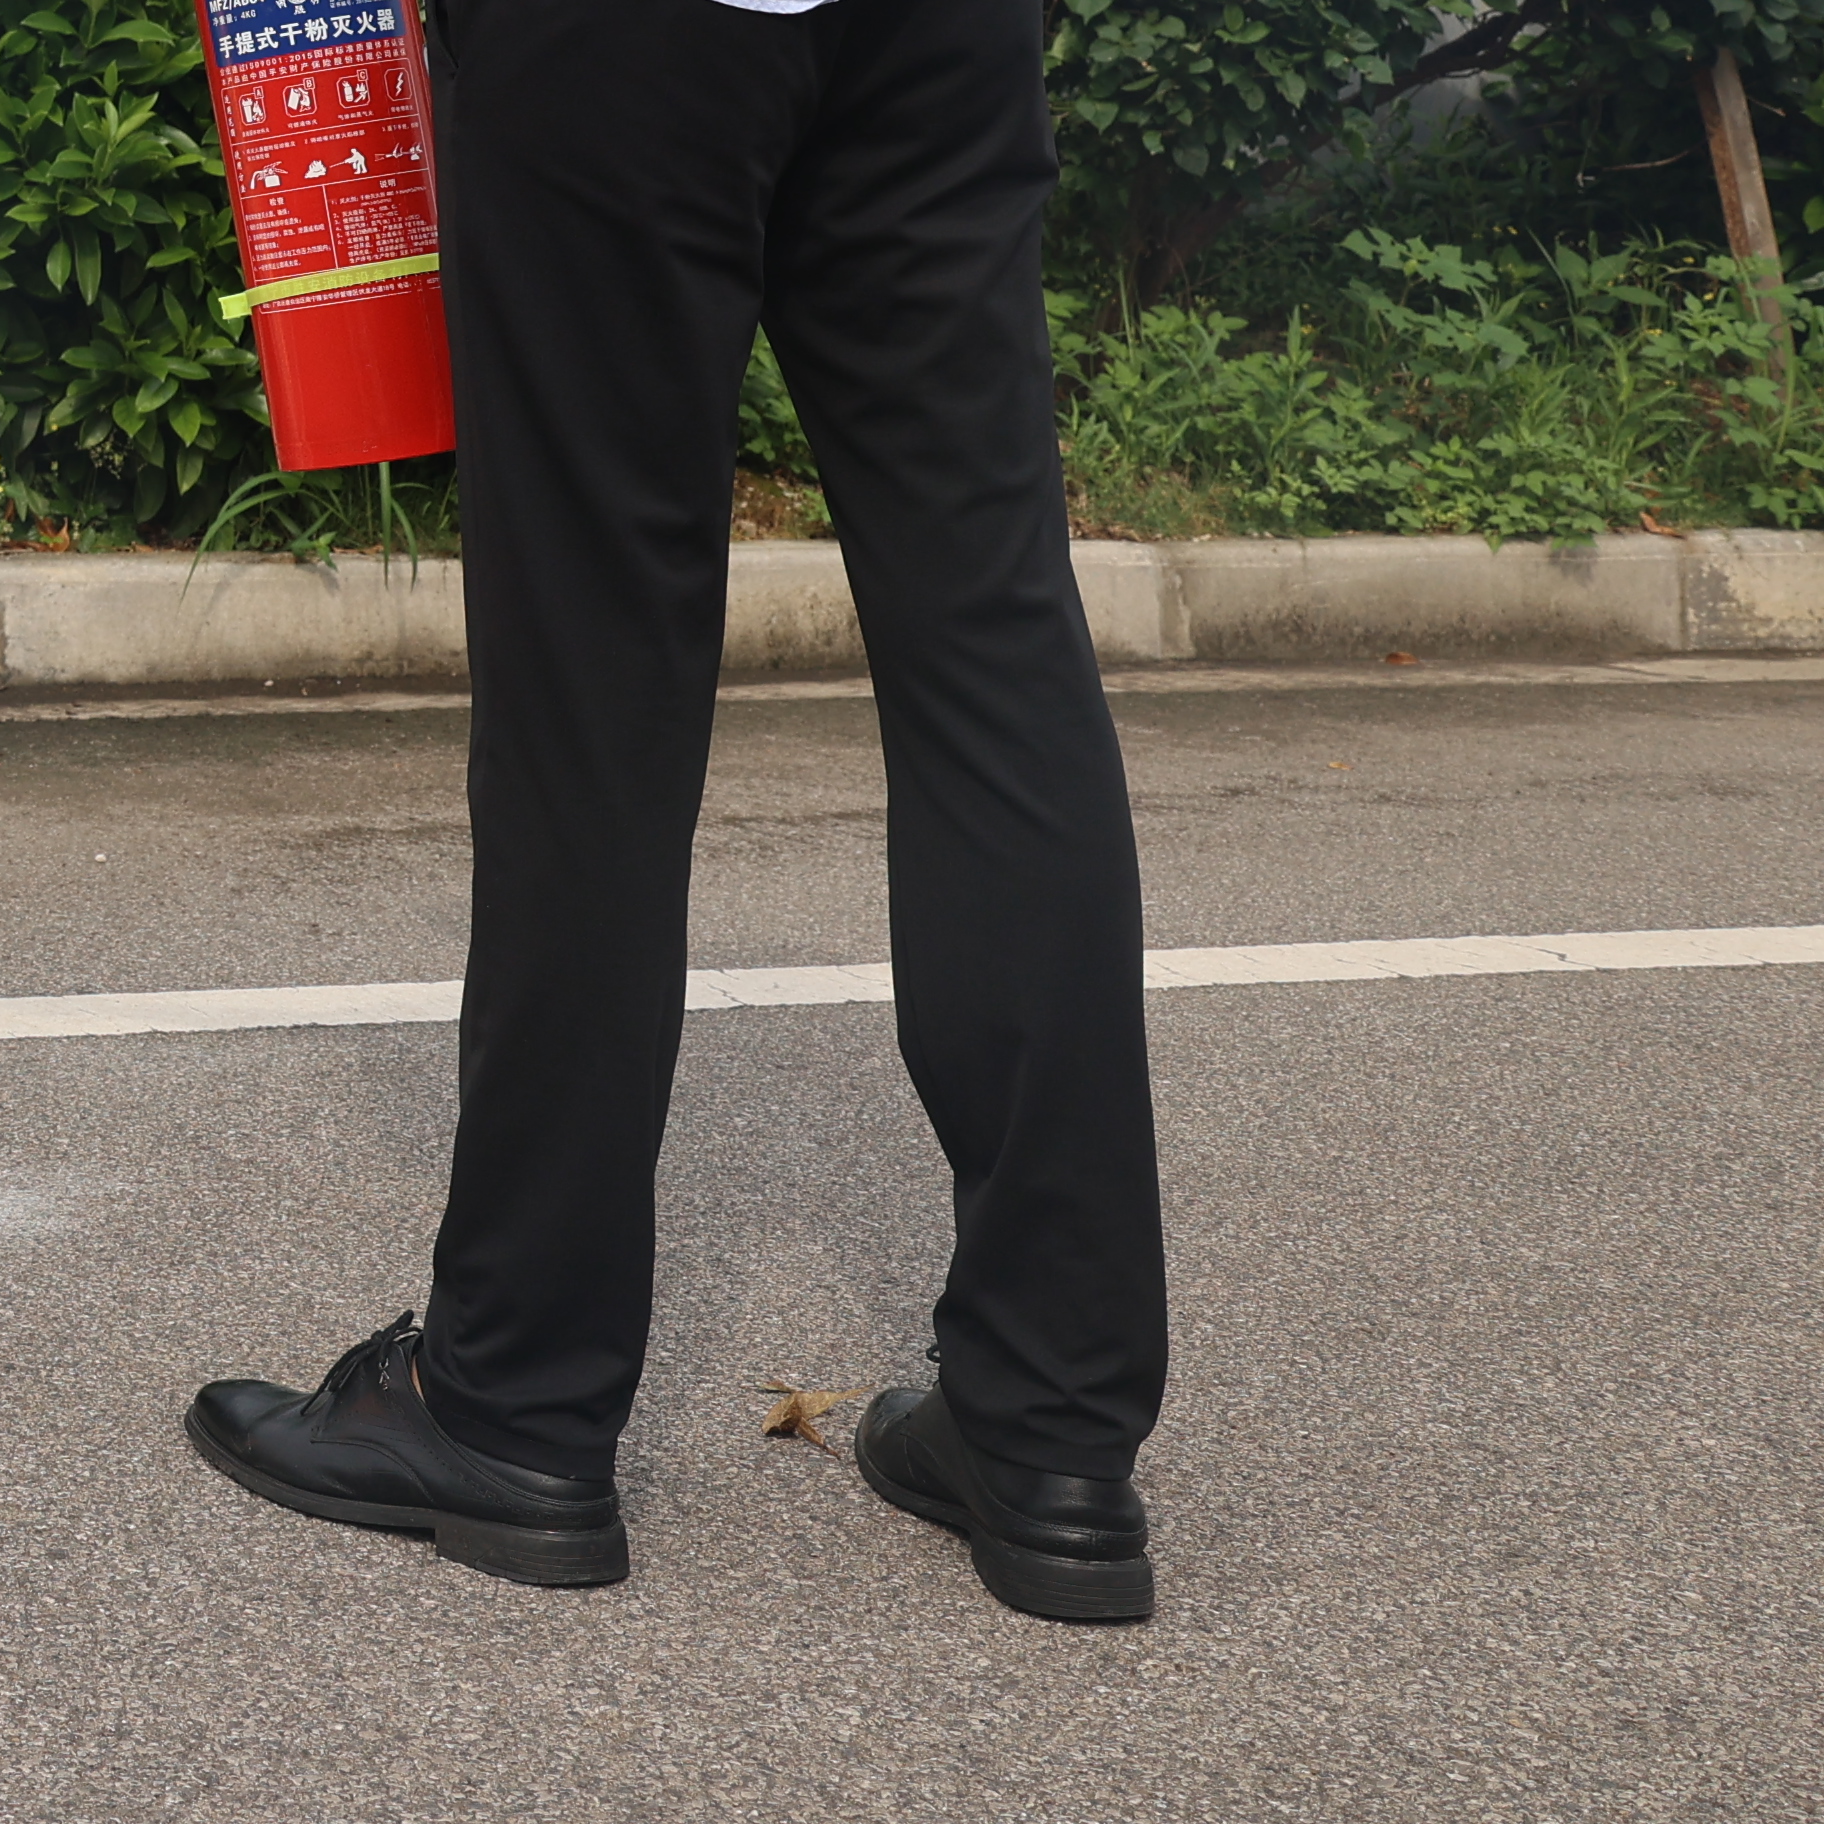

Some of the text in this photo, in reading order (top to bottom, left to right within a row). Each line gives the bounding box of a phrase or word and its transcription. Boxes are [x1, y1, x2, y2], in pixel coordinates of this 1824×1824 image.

[240, 9, 257, 20] 4KG
[219, 8, 396, 59] 手提式干粉灭火器
[359, 71, 366, 81] C
[305, 79, 313, 89] B
[379, 178, 397, 188] 说明
